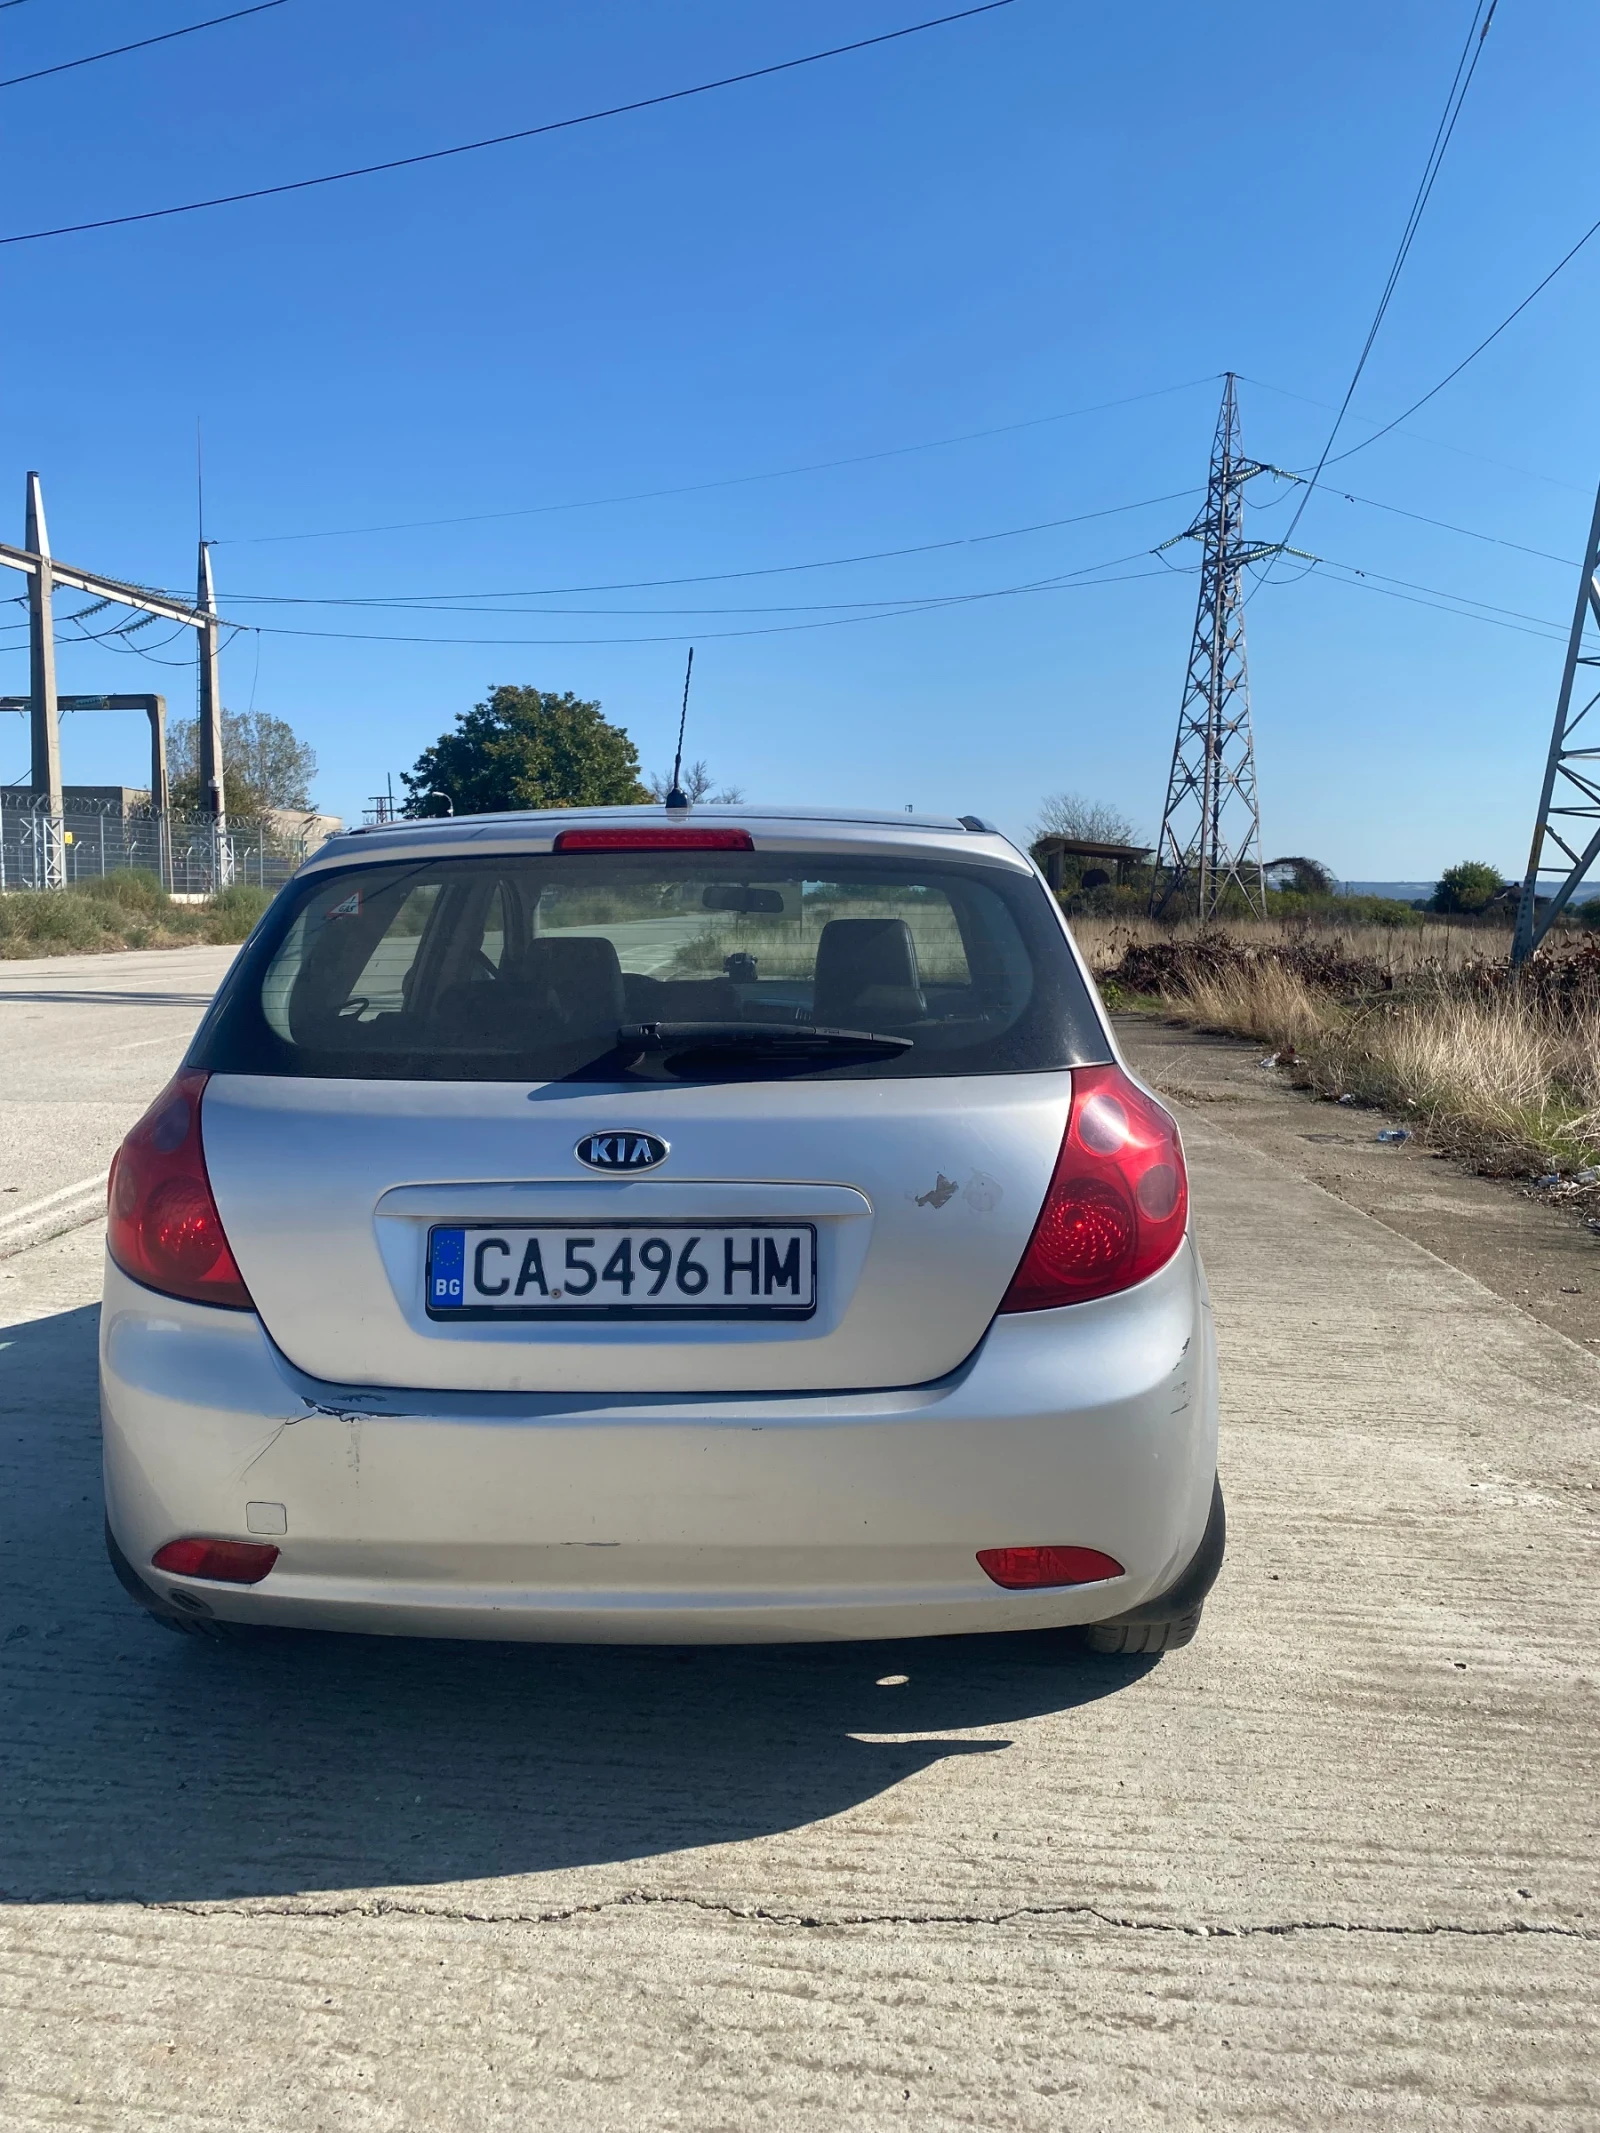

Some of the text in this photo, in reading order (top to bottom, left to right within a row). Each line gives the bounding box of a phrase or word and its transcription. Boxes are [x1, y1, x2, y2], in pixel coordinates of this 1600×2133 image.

[338, 905, 357, 913] GAS
[590, 1138, 653, 1162] KIA
[473, 1237, 800, 1296] CA 5496 HM
[436, 1279, 460, 1295] BG
